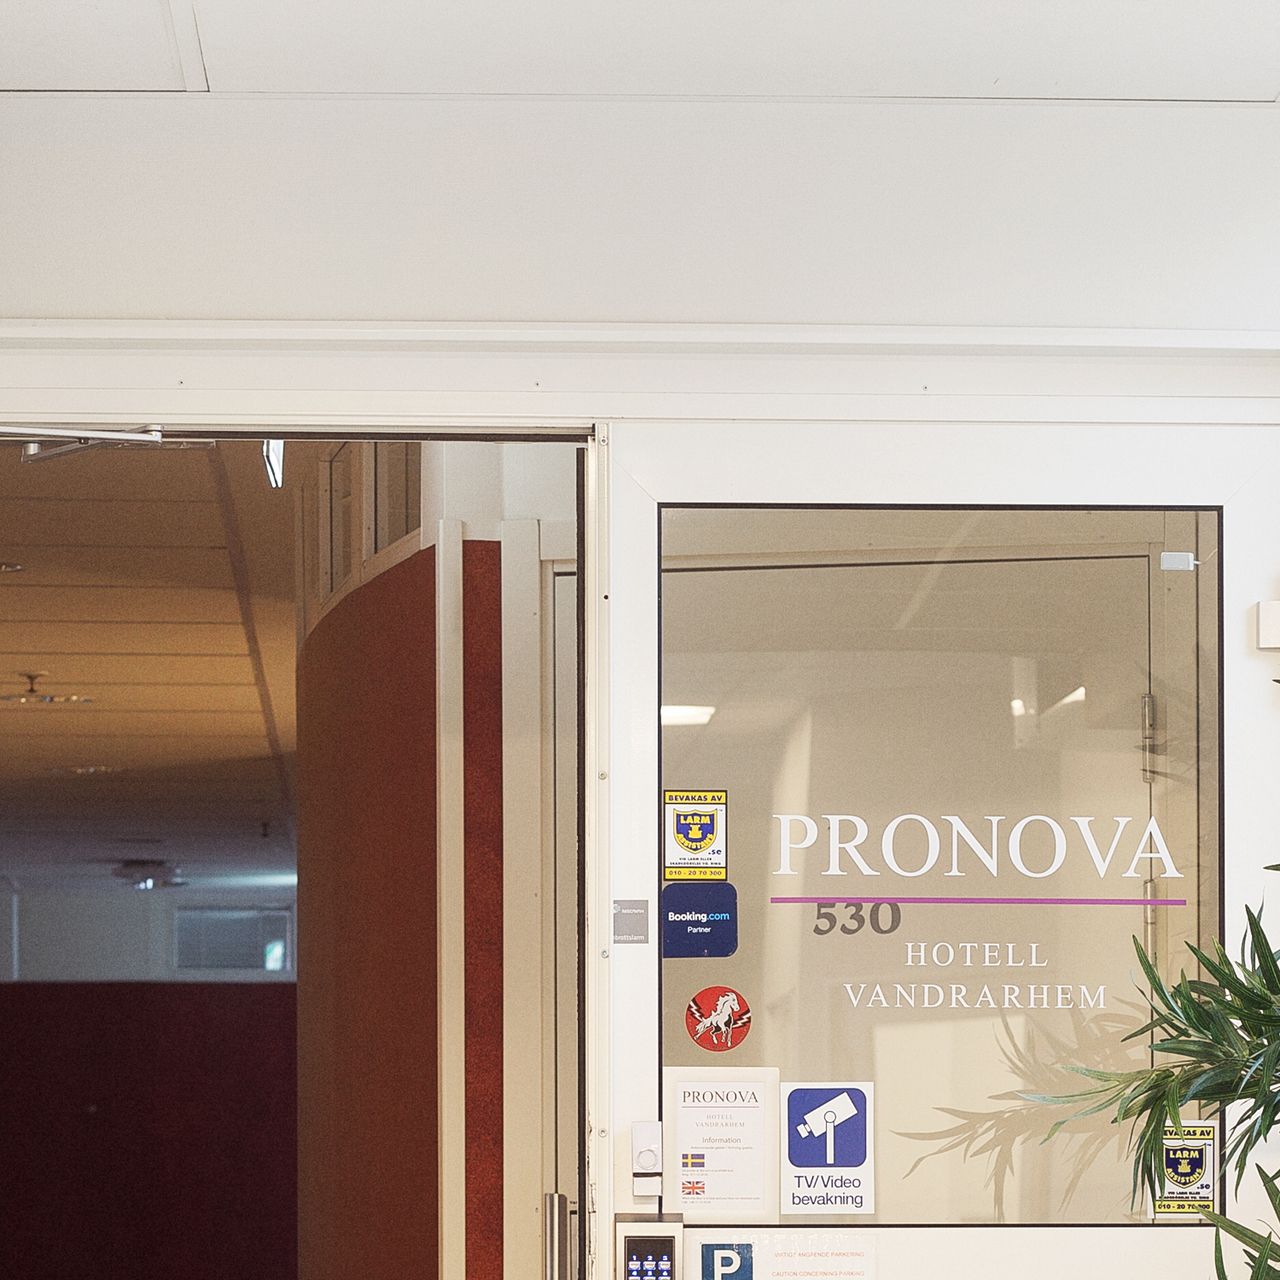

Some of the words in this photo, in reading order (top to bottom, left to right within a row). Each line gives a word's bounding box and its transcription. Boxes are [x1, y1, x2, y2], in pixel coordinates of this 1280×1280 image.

[680, 816, 710, 824] LARM
[772, 814, 1185, 878] PRONOVA
[668, 912, 730, 922] Booking.com
[813, 903, 902, 936] 530
[904, 942, 1048, 967] HOTELL
[843, 983, 1107, 1009] VANDRARHEM
[682, 1091, 758, 1103] PRONOVA
[1169, 1150, 1199, 1158] LARM
[1166, 1168, 1202, 1183] ASSISTANS
[792, 1192, 863, 1208] bevakning
